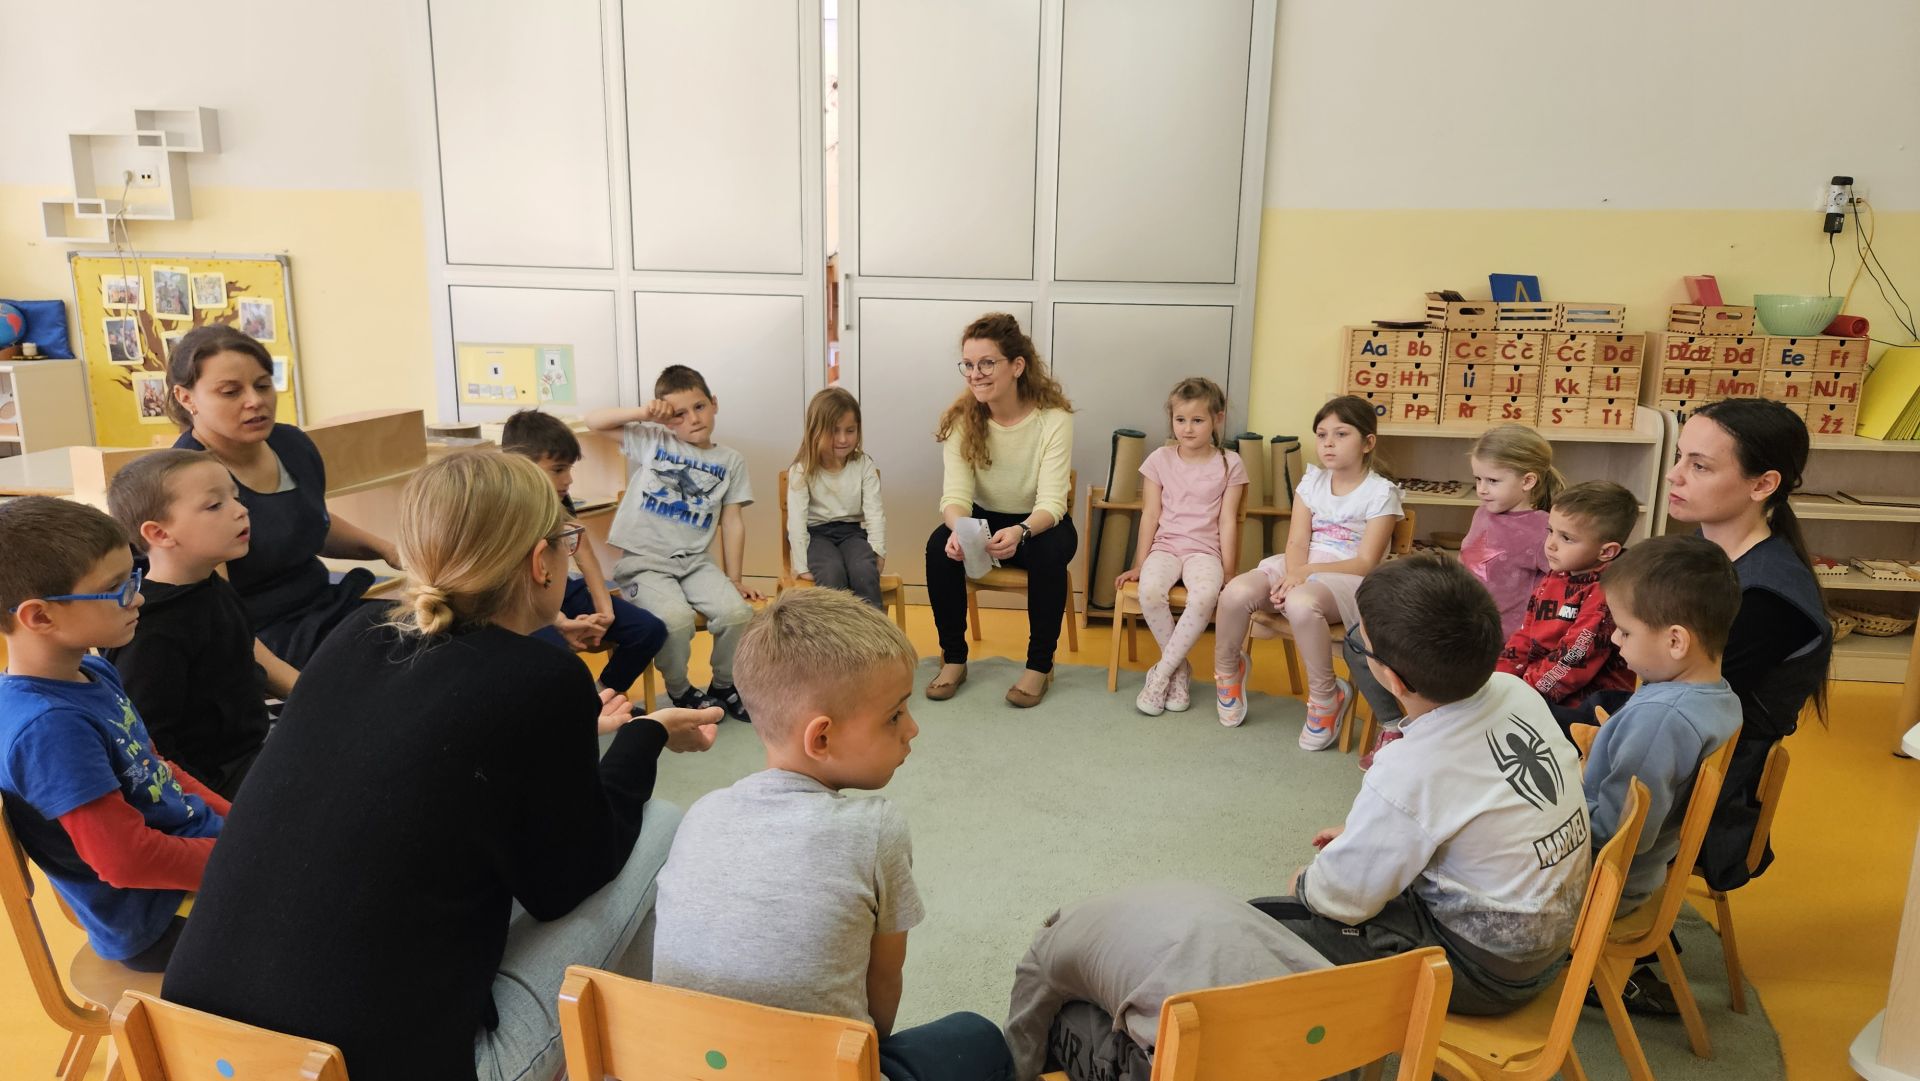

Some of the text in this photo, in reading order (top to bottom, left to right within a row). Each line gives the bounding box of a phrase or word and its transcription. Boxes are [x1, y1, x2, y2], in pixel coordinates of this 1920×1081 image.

[1361, 339, 1388, 356] Aa
[1407, 340, 1432, 356] Bb
[1781, 348, 1805, 366] Ee
[1830, 350, 1850, 368] Ff
[1463, 372, 1476, 388] Ii
[1505, 373, 1523, 394] Jj
[1555, 378, 1580, 395] Kk
[1716, 379, 1755, 395] Mm
[1404, 403, 1430, 420] Pp
[1458, 402, 1477, 418] Rr
[1502, 403, 1522, 420] Ss
[1602, 408, 1622, 425] Tt
[1533, 808, 1587, 869] MARVEL
